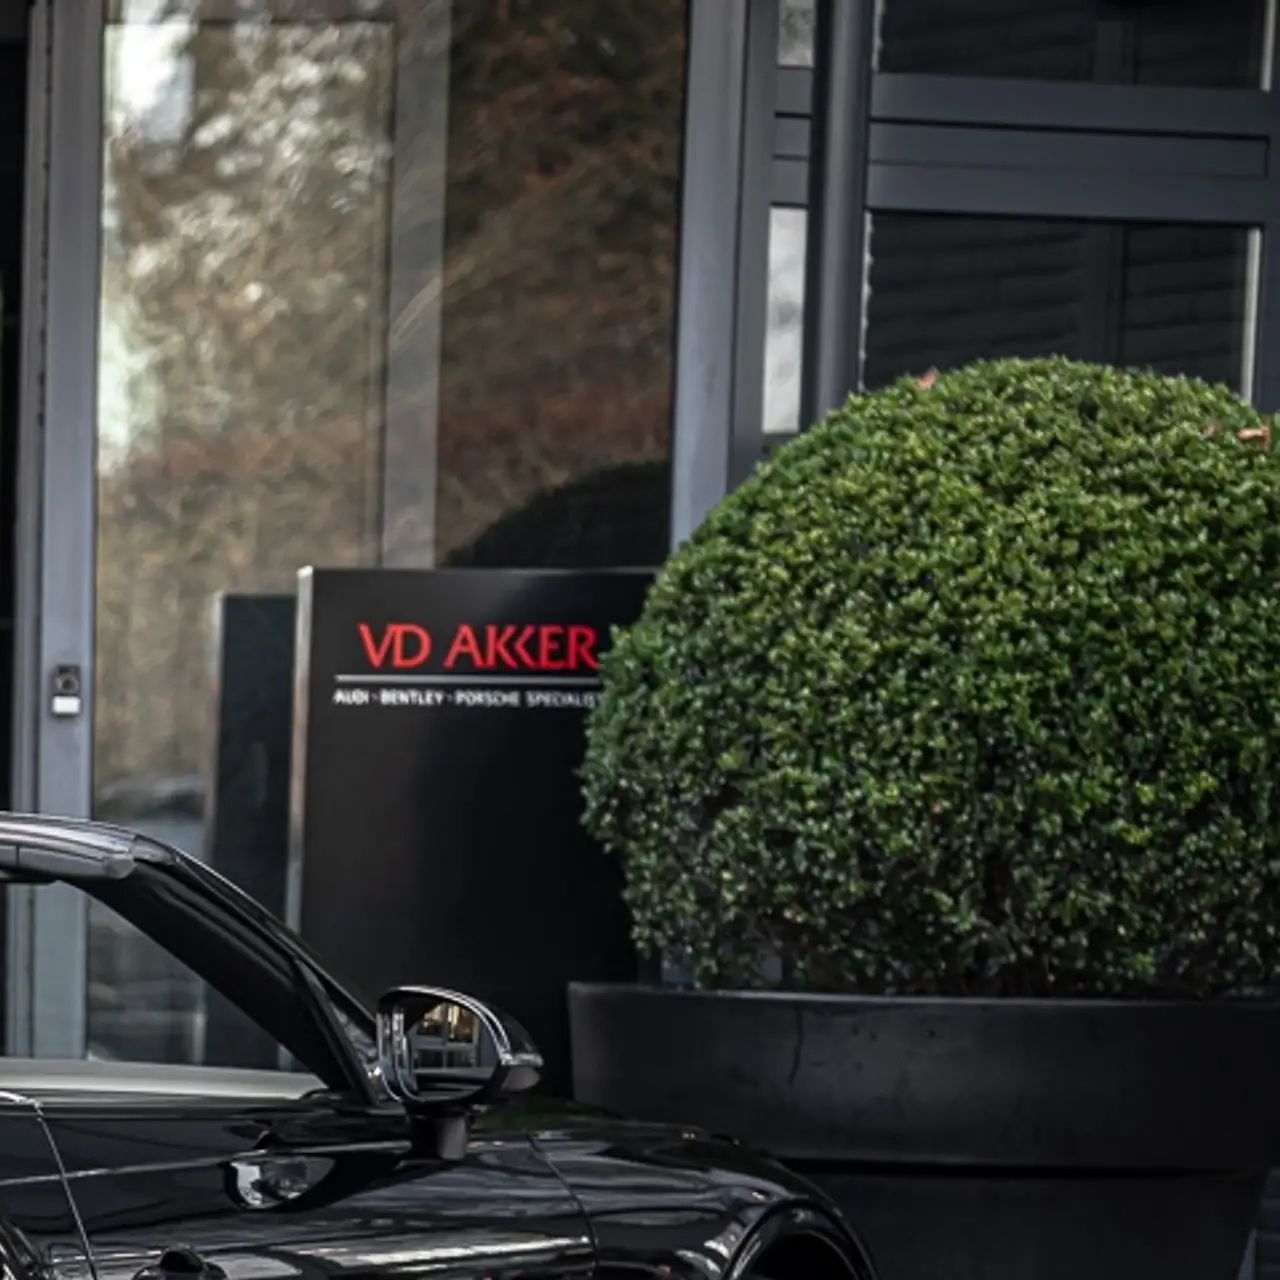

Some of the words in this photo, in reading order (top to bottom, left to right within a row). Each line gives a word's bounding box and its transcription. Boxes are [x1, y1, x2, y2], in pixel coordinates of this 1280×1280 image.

[357, 623, 432, 669] VD
[443, 624, 600, 669] AKKER
[334, 688, 370, 706] AUDI
[379, 688, 444, 707] BENTLEY
[454, 689, 520, 708] PORSCHE
